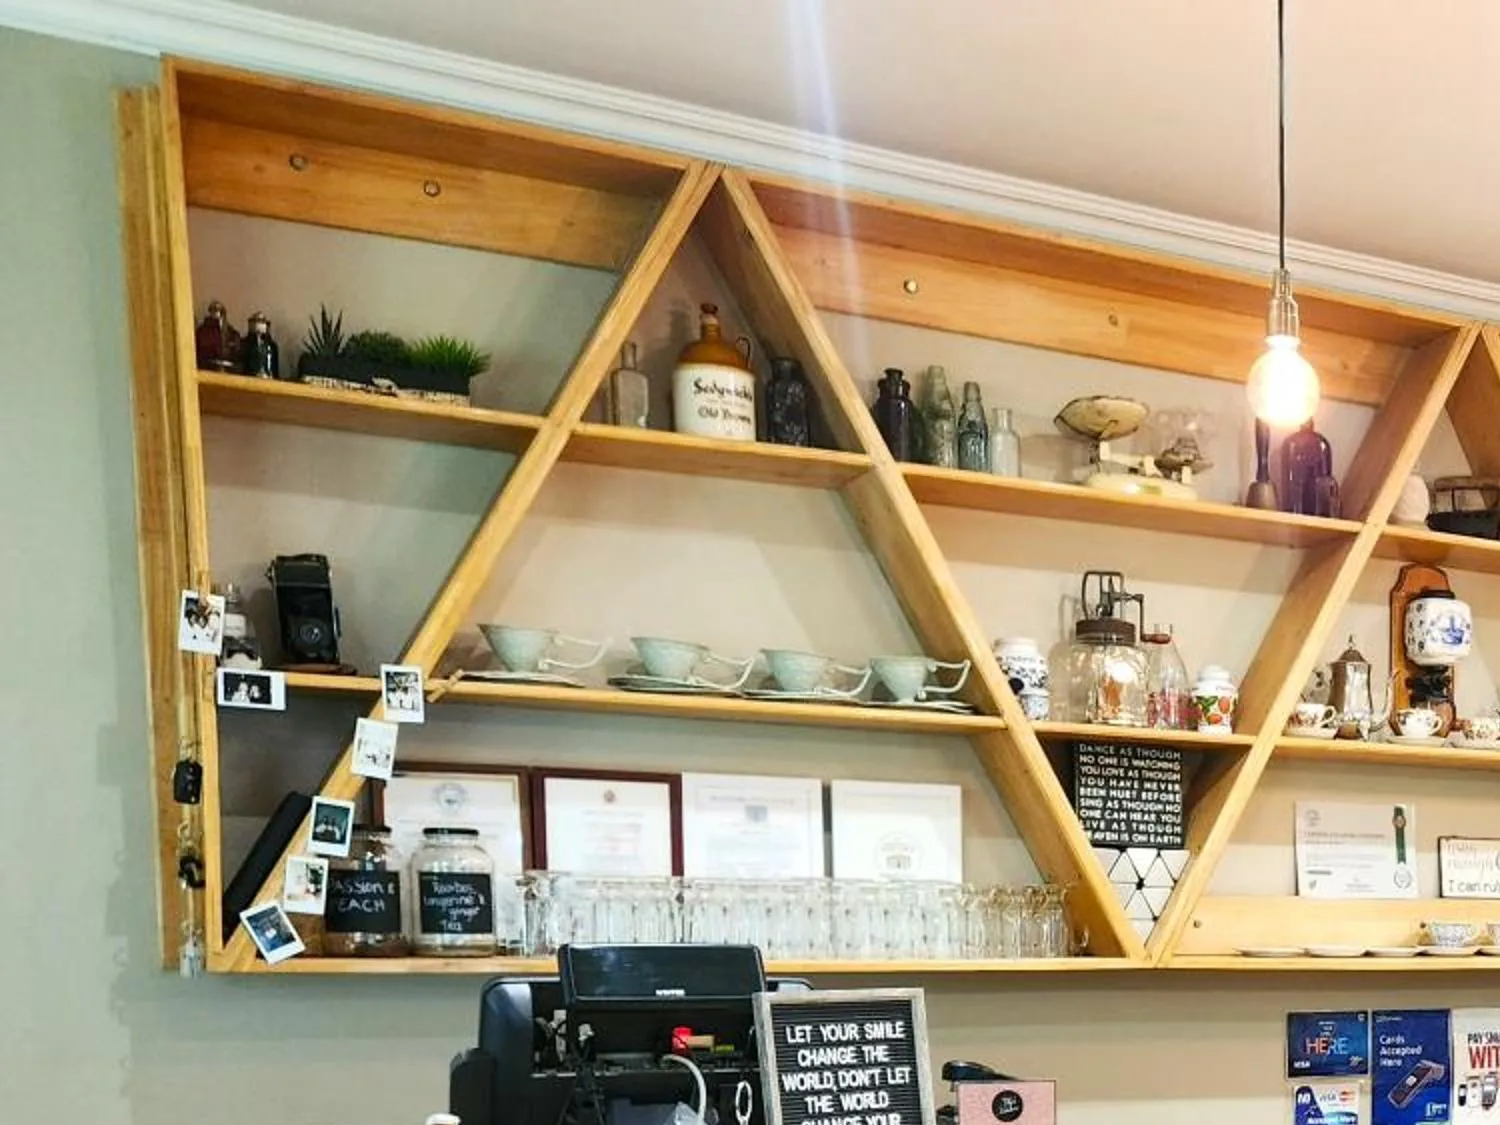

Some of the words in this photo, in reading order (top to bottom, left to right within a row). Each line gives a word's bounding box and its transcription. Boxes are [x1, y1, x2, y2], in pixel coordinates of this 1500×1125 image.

[1080, 744, 1115, 755] DANCE
[1120, 748, 1132, 757] AS
[1136, 749, 1180, 759] THOUGH
[1080, 755, 1095, 765] NO
[1097, 756, 1118, 767] ONE
[1080, 766, 1101, 775] YOU
[1101, 767, 1125, 777] LOVE
[1128, 770, 1139, 779] AS
[1141, 771, 1180, 781] THOUGH
[1080, 777, 1105, 786] YOU
[1109, 779, 1139, 789] HAVE
[1143, 781, 1180, 791] NEVER
[1080, 788, 1107, 797] BEEN
[1109, 790, 1137, 799] HURT
[1141, 792, 1181, 802] BEFORE
[1080, 798, 1103, 808] SING
[1106, 800, 1119, 809] AS
[1121, 801, 1164, 811] THOUGH
[1165, 803, 1180, 813] NO
[1080, 809, 1101, 819] ONE
[1104, 810, 1127, 820] CAN
[1129, 812, 1157, 822] HEAR
[1160, 813, 1181, 823] YOU
[1111, 822, 1126, 831] AS
[1131, 822, 1181, 834] THOUGH
[1086, 830, 1118, 841] EAVEN
[1131, 834, 1148, 843] ON
[1149, 835, 1181, 844] EARTH
[337, 898, 386, 913] EACH
[785, 1025, 812, 1044] LET
[820, 1023, 859, 1042] YOUR
[863, 1021, 906, 1040] SMILE
[1467, 1032, 1483, 1044] PAY
[1305, 1037, 1349, 1055] HERE
[1379, 1035, 1405, 1045] Cards
[797, 1046, 857, 1067] CHANGE
[862, 1045, 890, 1063] THE
[1379, 1045, 1423, 1057] Accepted
[782, 1071, 837, 1093] WORLD,
[838, 1068, 881, 1088] DON'T
[887, 1066, 912, 1084] LET
[804, 1095, 835, 1115] THE
[840, 1090, 890, 1111] WORLD
